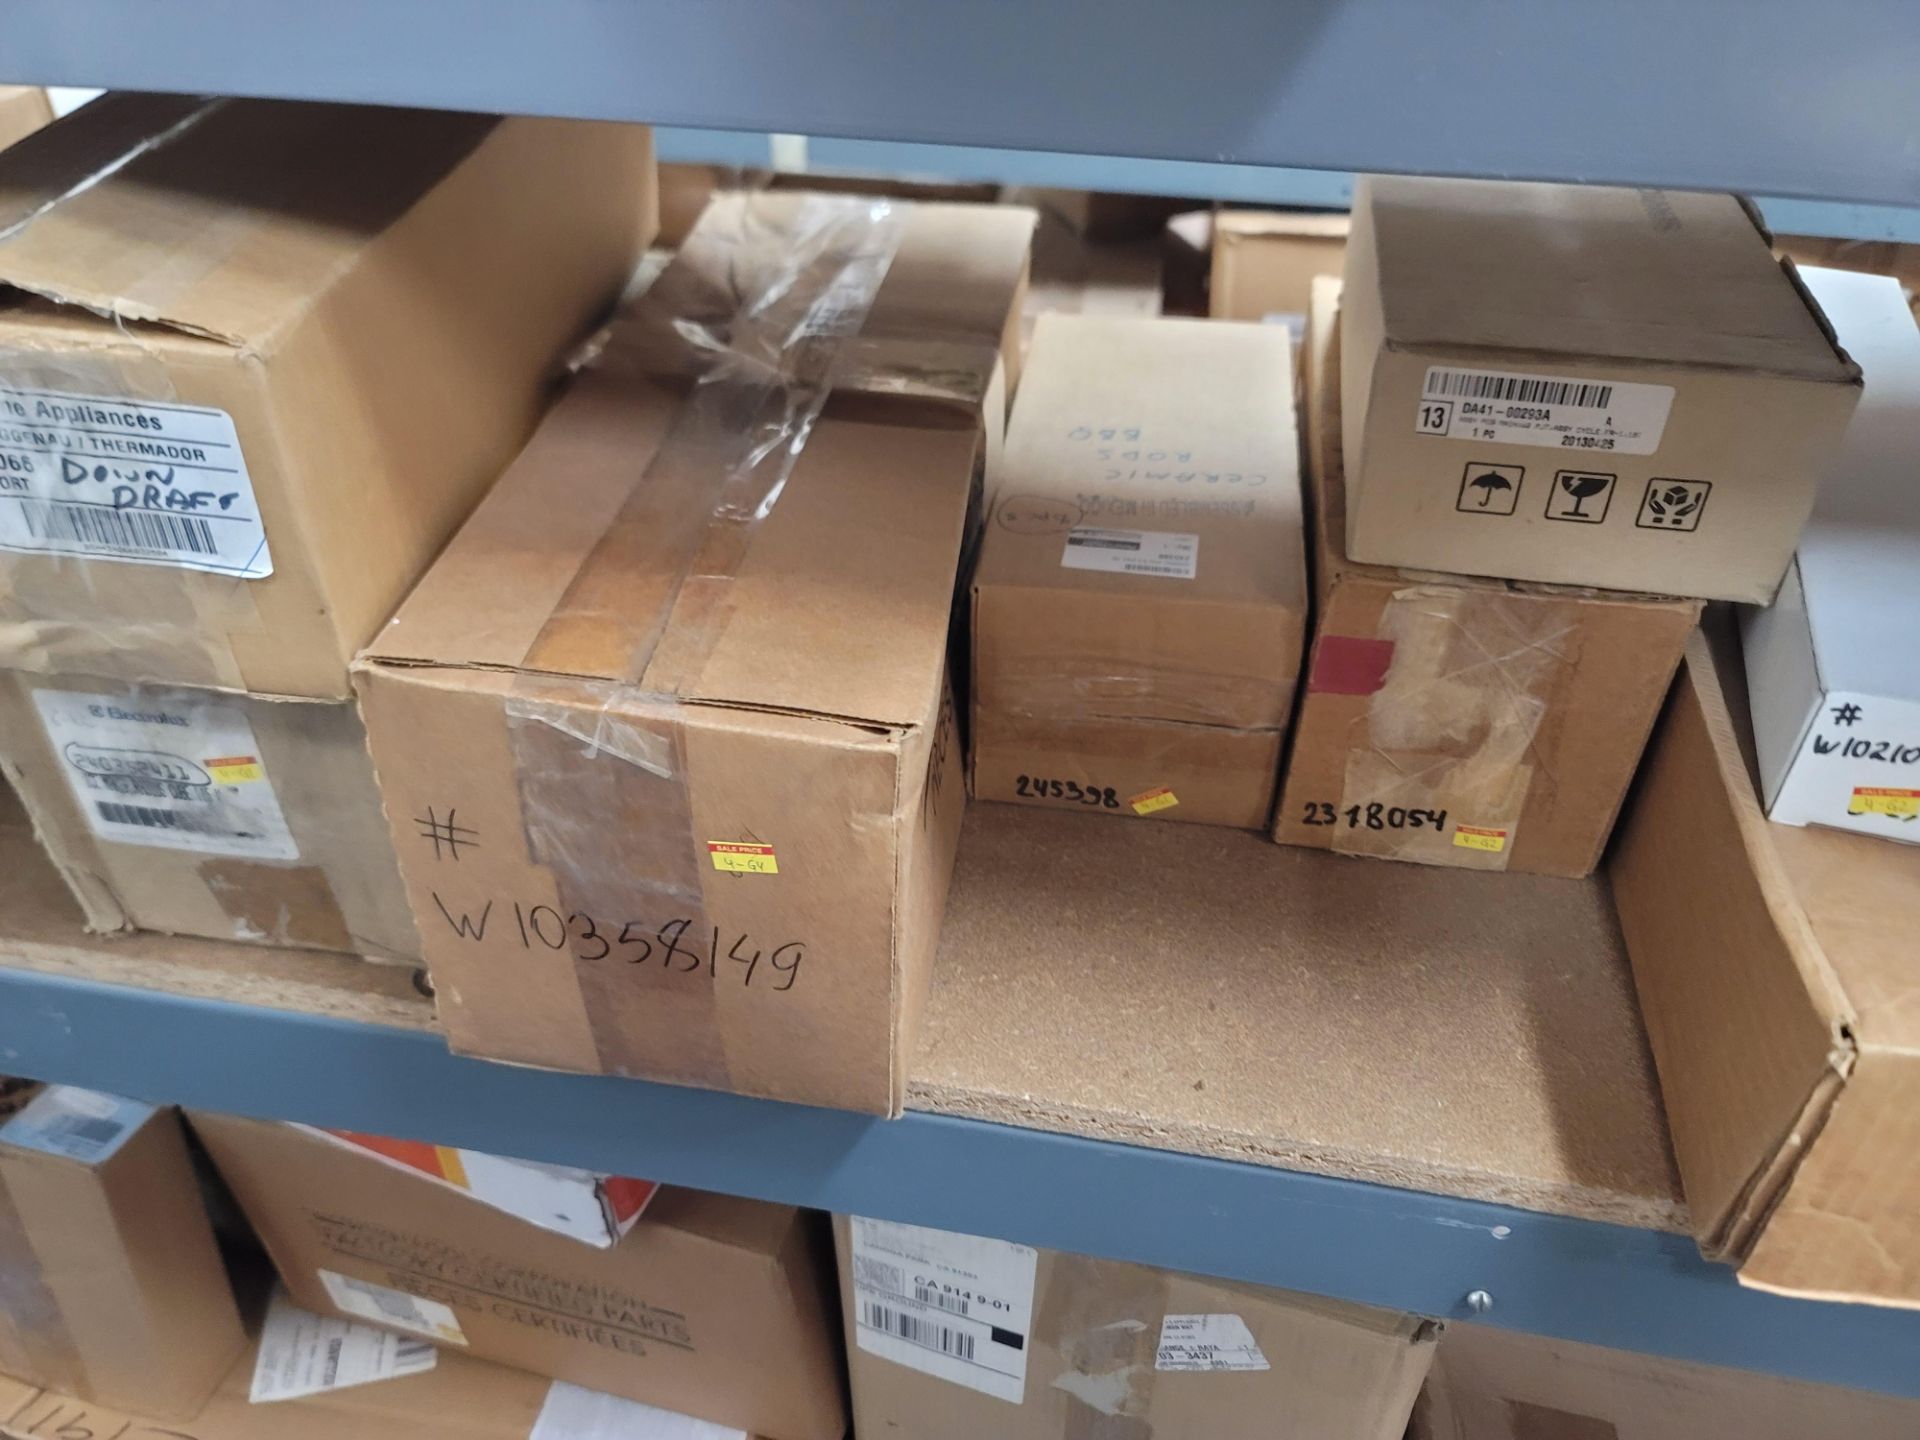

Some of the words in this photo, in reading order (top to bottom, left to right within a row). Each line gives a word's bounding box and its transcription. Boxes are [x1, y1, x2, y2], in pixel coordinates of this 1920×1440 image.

[36, 400, 163, 432] Appliances
[1421, 406, 1445, 429] 13
[1068, 427, 1142, 441] BBQ
[91, 437, 207, 463] THERMADOR
[1105, 470, 1267, 486] CERAMIC
[108, 705, 190, 727] Electrolux
[1830, 703, 1862, 726] #
[1302, 801, 1447, 832] 2318054
[413, 806, 480, 861] #
[716, 844, 737, 852] SALE
[738, 846, 763, 855] PRICE
[914, 1275, 939, 1290] CA
